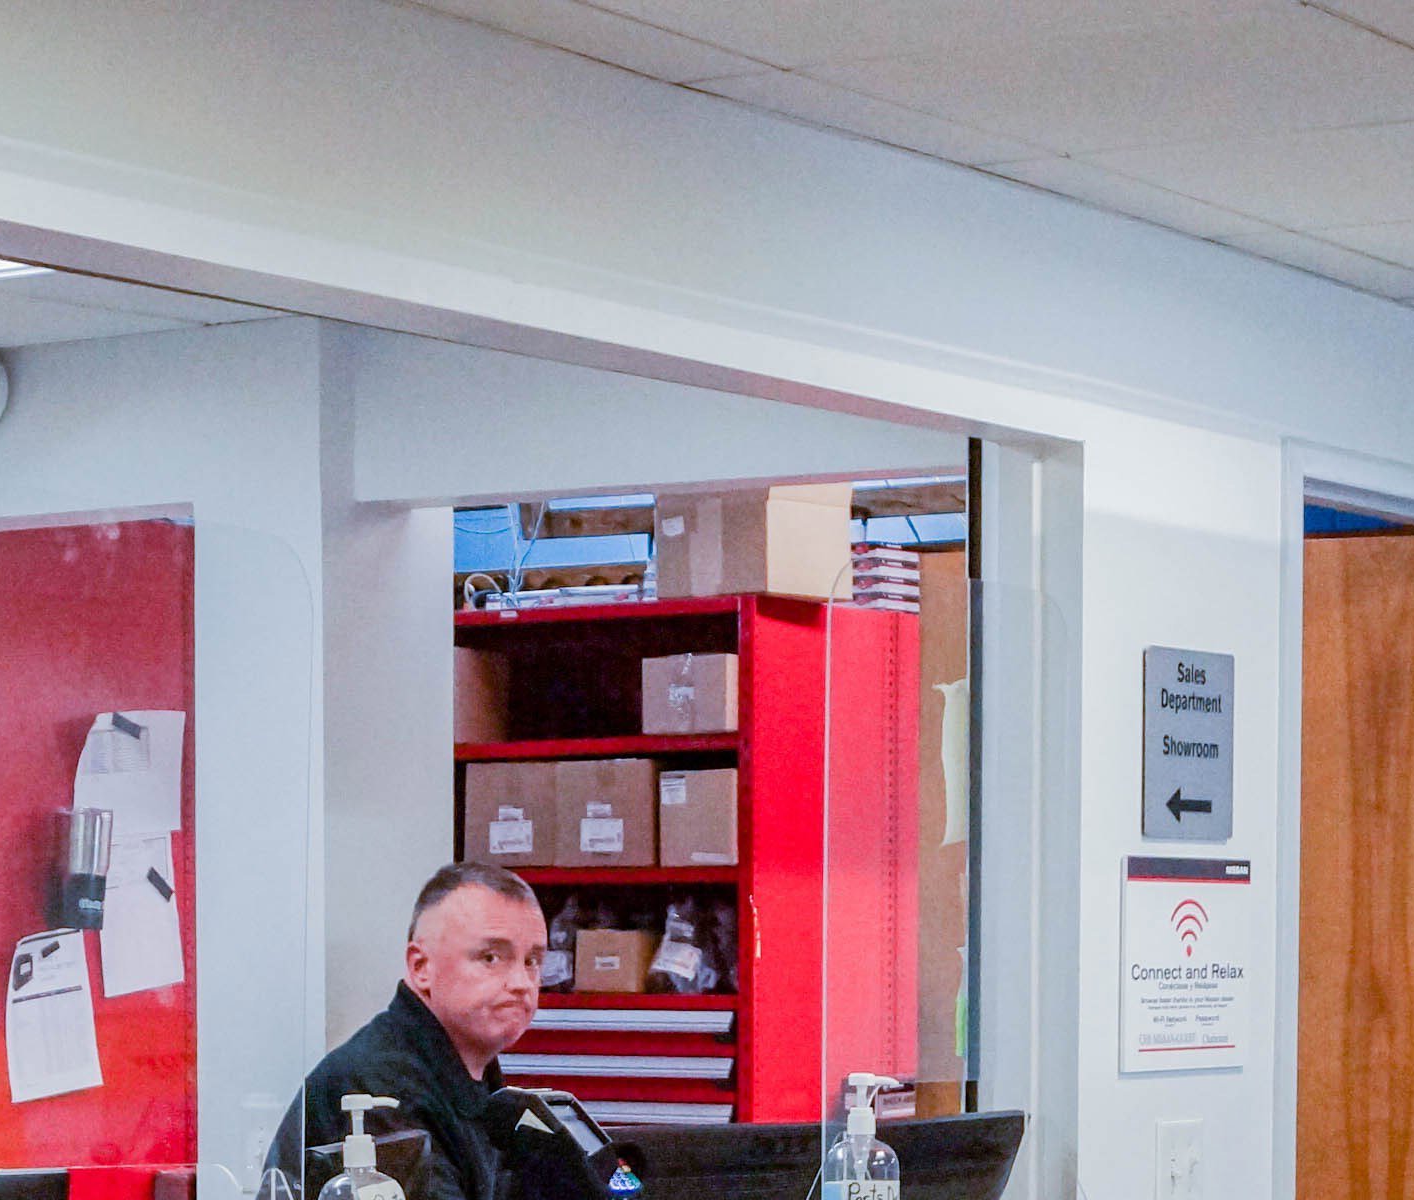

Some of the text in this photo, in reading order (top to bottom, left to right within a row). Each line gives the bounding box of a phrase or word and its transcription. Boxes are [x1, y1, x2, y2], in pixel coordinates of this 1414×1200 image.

[1177, 662, 1206, 685] Sales
[1161, 688, 1222, 714] Department
[1163, 734, 1219, 759] Showroom
[1131, 963, 1244, 980] Connect and Relax
